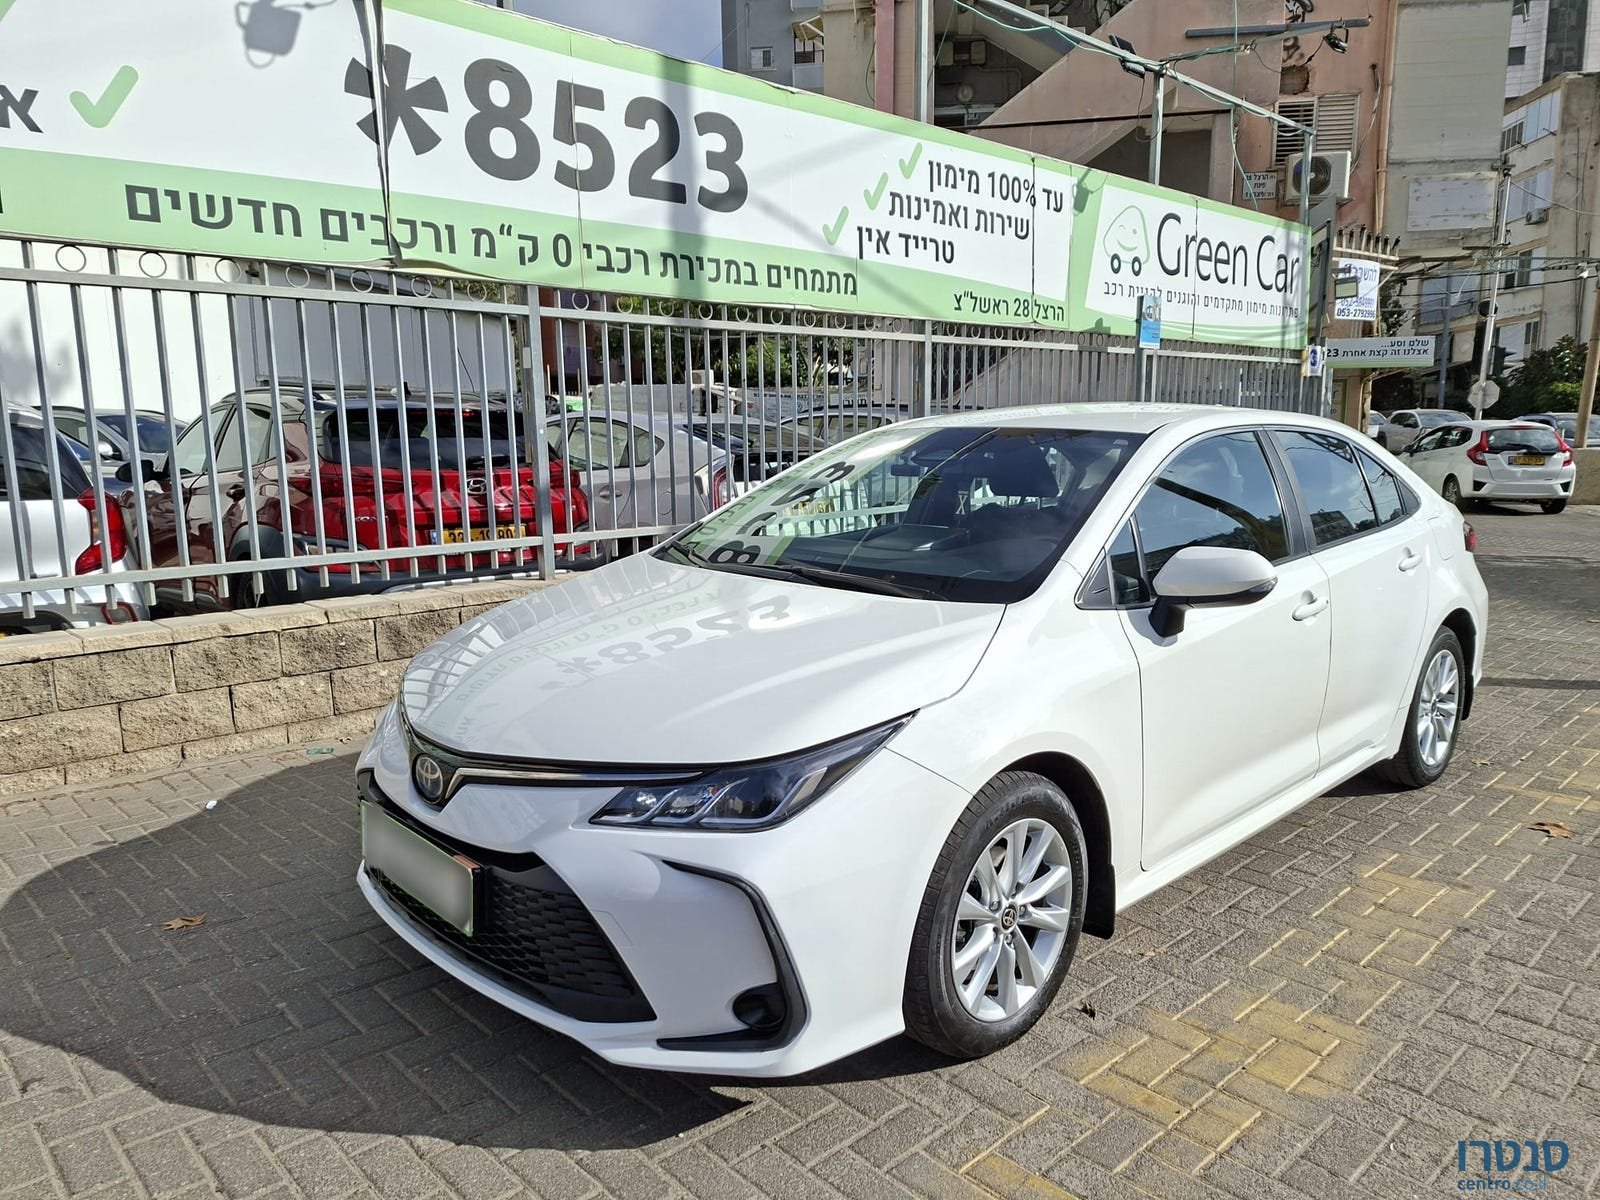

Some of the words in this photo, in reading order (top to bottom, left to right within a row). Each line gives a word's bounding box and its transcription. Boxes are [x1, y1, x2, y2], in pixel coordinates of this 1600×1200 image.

[928, 160, 980, 195] מימון
[988, 171, 1036, 208] 100%
[125, 184, 302, 238] חדשים
[889, 191, 968, 229] ואמינות
[1042, 187, 1063, 213] עד
[320, 208, 456, 254] ורכבים
[975, 208, 1030, 240] שירות
[552, 233, 572, 268] 0
[582, 242, 649, 276] רכבי
[857, 226, 891, 260] אין
[898, 232, 955, 264] טרייד
[1157, 212, 1248, 287] Green
[1256, 234, 1300, 294] Car
[660, 250, 759, 287] במכירת
[767, 263, 857, 296] מתמחים
[1104, 281, 1124, 297] רכב
[1166, 290, 1200, 306] והוגנים
[1204, 295, 1243, 313] מתקדמים
[1013, 297, 1030, 318] 28
[1034, 298, 1065, 322] הרצל
[1246, 301, 1267, 316] מימון
[1342, 349, 1366, 358] אחרת
[1369, 348, 1388, 358] קצת
[1390, 348, 1401, 356] זה
[1403, 347, 1429, 356] אצלנו
[1408, 338, 1429, 347] שלם
